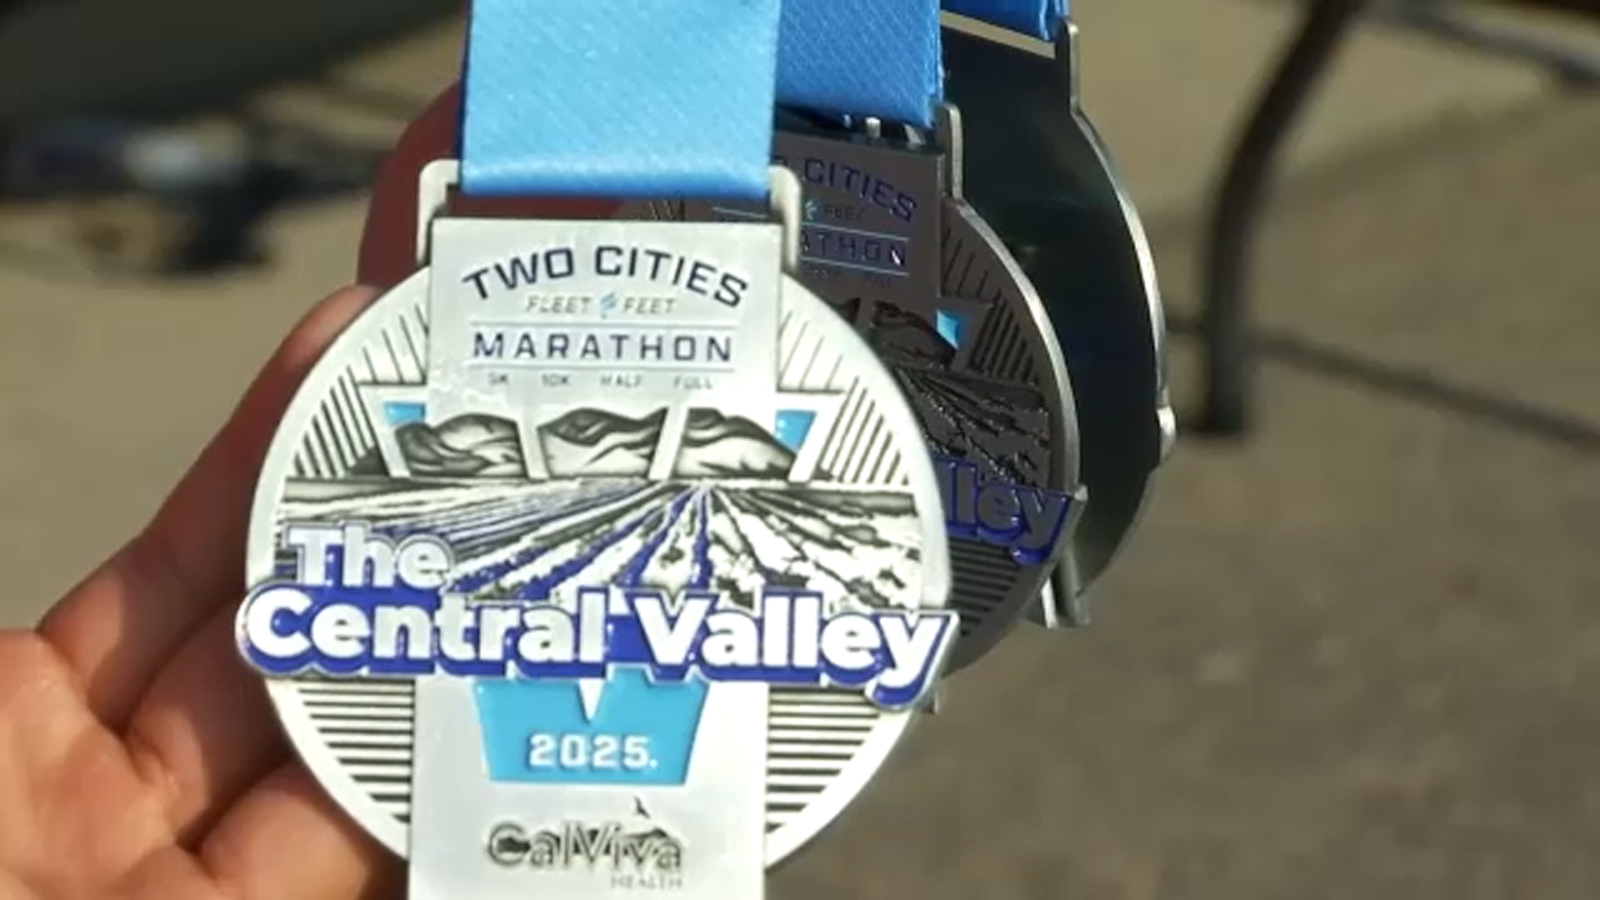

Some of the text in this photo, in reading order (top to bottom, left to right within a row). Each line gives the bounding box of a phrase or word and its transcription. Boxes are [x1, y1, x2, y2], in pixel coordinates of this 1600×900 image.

[804, 157, 917, 223] CITIES
[461, 246, 748, 308] TWO CITIES
[525, 295, 677, 315] FLEET FEET
[473, 332, 732, 362] MARATHON
[600, 374, 643, 389] HALF
[286, 524, 450, 588] The
[247, 586, 946, 688] Central Valley
[486, 821, 682, 868] CalViva
[611, 874, 683, 890] HEALTH
